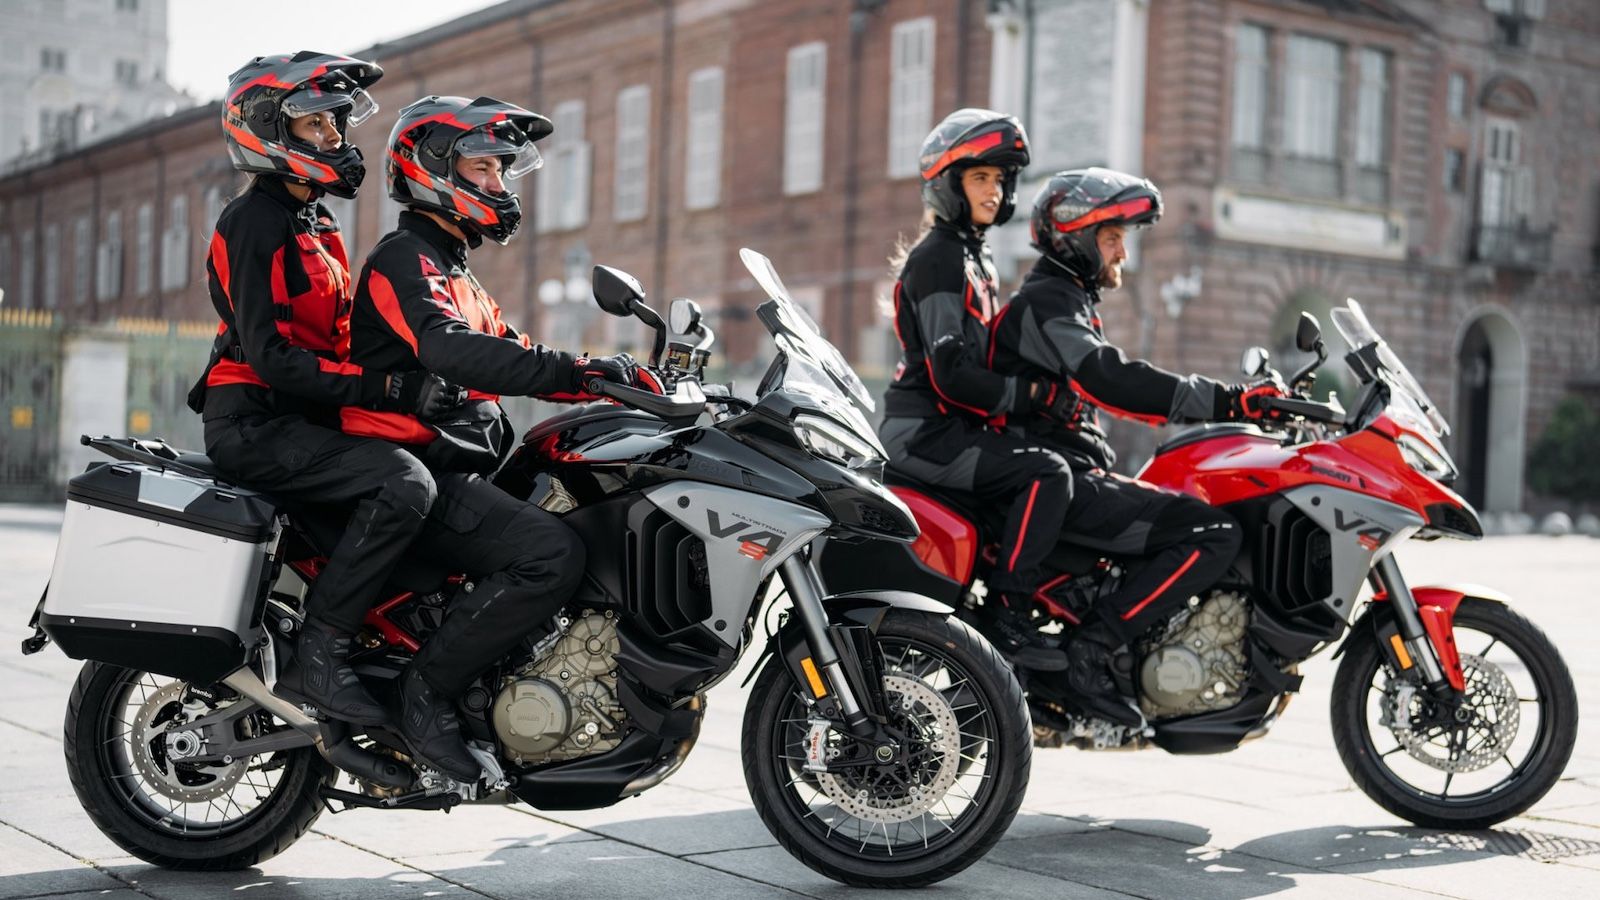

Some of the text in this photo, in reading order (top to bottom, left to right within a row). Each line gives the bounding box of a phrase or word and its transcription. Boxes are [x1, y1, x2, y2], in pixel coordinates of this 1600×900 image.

[706, 508, 785, 557] V4
[1334, 507, 1392, 545] V4
[191, 687, 213, 699] brembo
[810, 731, 820, 761] brembo
